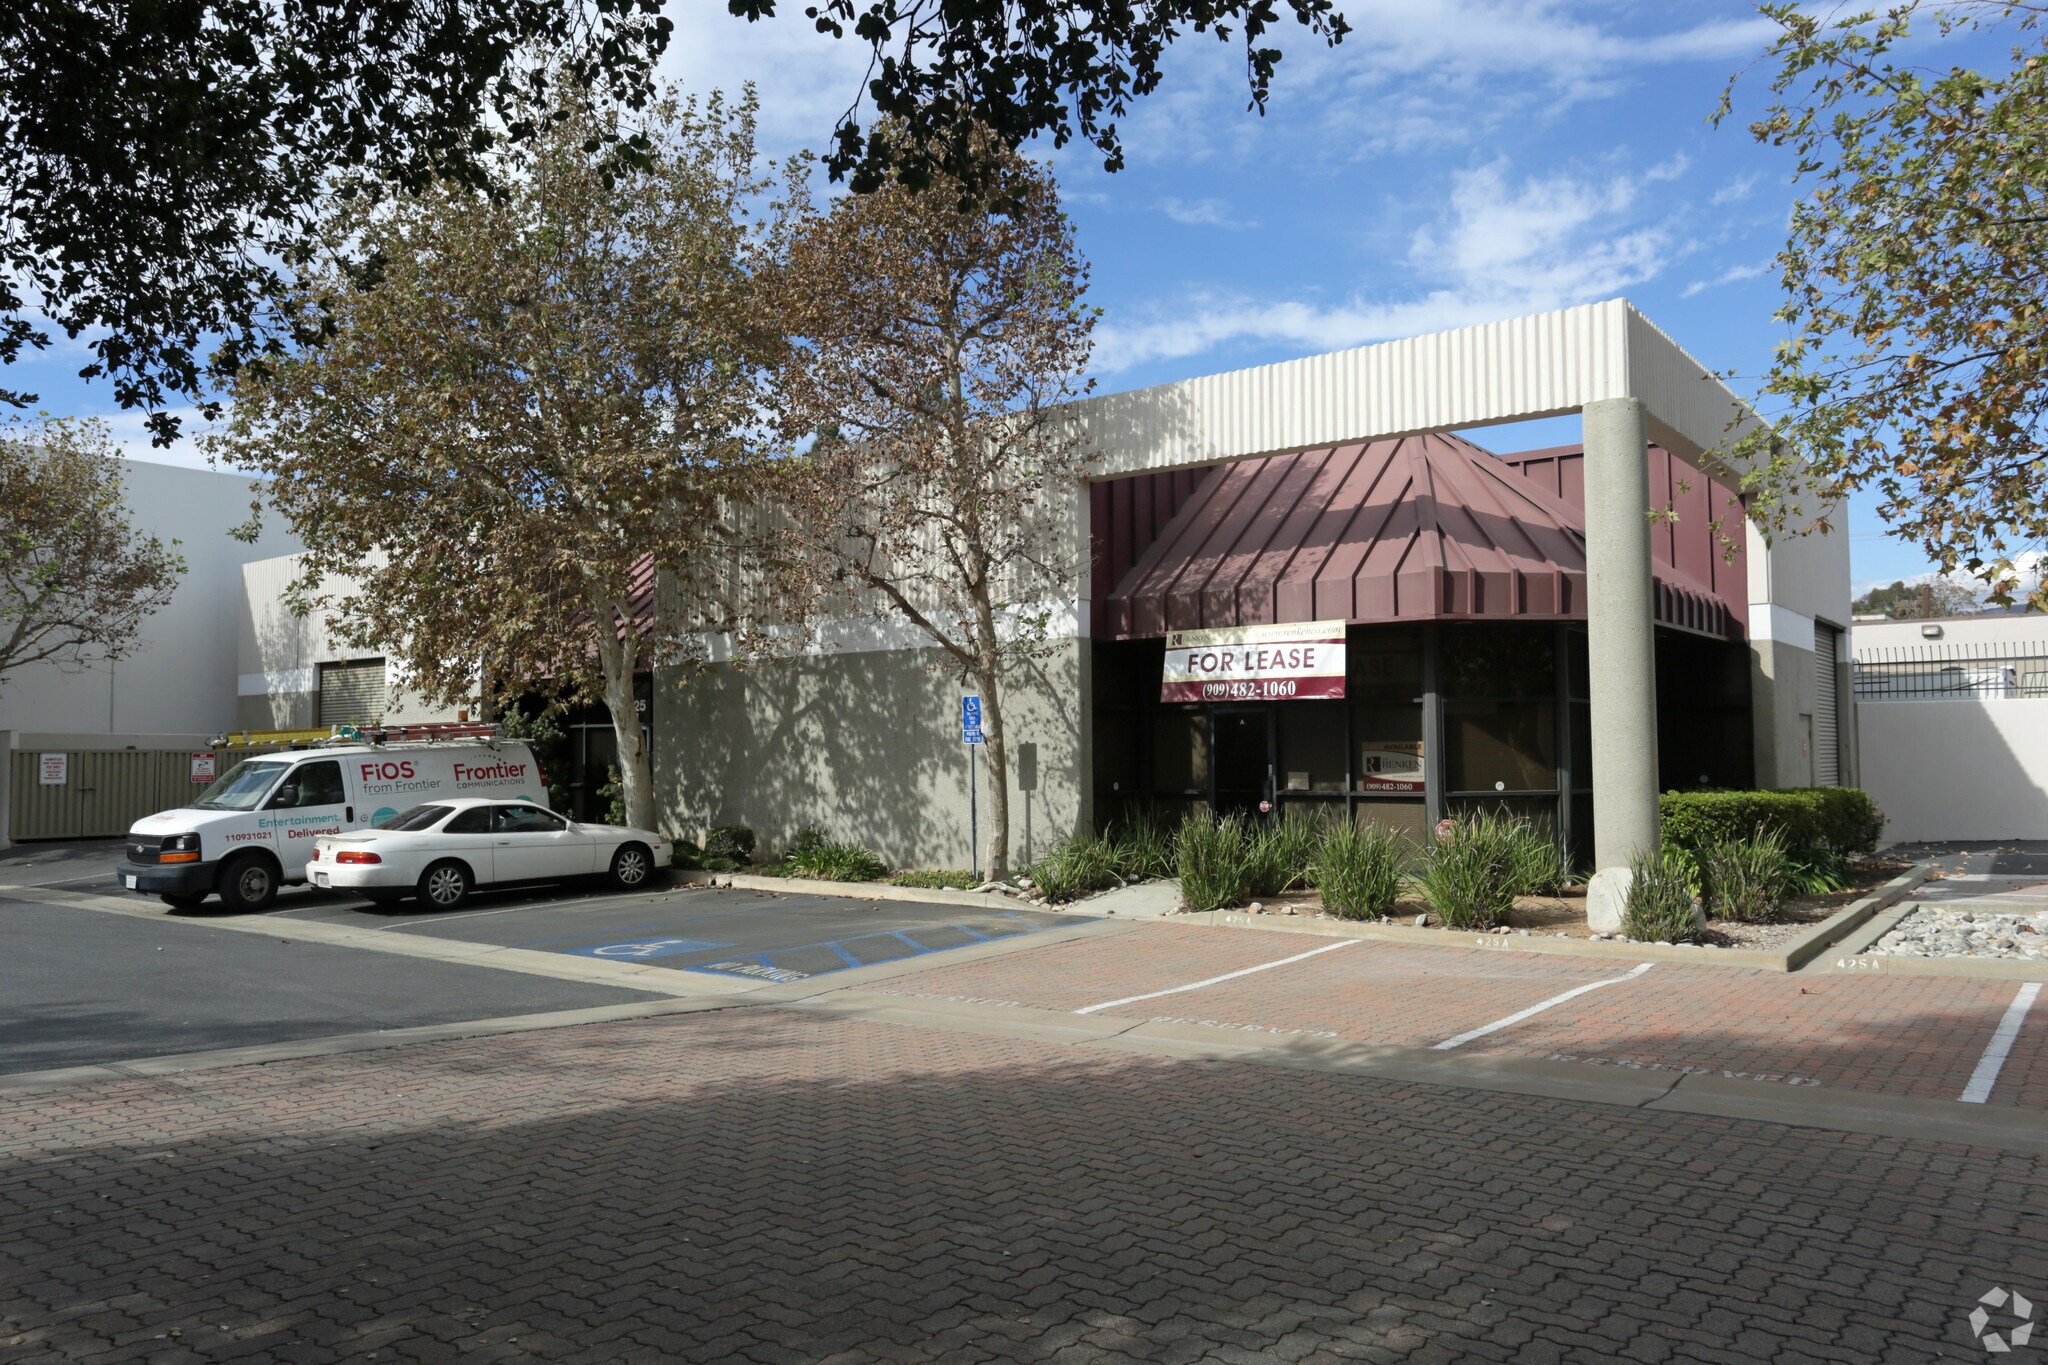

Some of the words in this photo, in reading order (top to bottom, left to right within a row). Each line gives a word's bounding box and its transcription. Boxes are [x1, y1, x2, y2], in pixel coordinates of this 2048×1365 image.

[1188, 652, 1234, 673] FOR
[1244, 648, 1315, 670] LEASE
[360, 761, 415, 781] FiOS
[1382, 760, 1422, 769] RENKEN
[453, 762, 526, 781] Frontier
[363, 783, 393, 794] from
[395, 779, 441, 792] Frontier
[456, 778, 526, 789] COMMUNICATIONS
[259, 814, 341, 828] Entertainment.
[225, 832, 272, 842] 110931021
[288, 826, 343, 839] Delivered.
[1476, 937, 1509, 948] 425A
[1837, 958, 1880, 970] 425A
[1549, 1054, 1821, 1087] RESERVED
